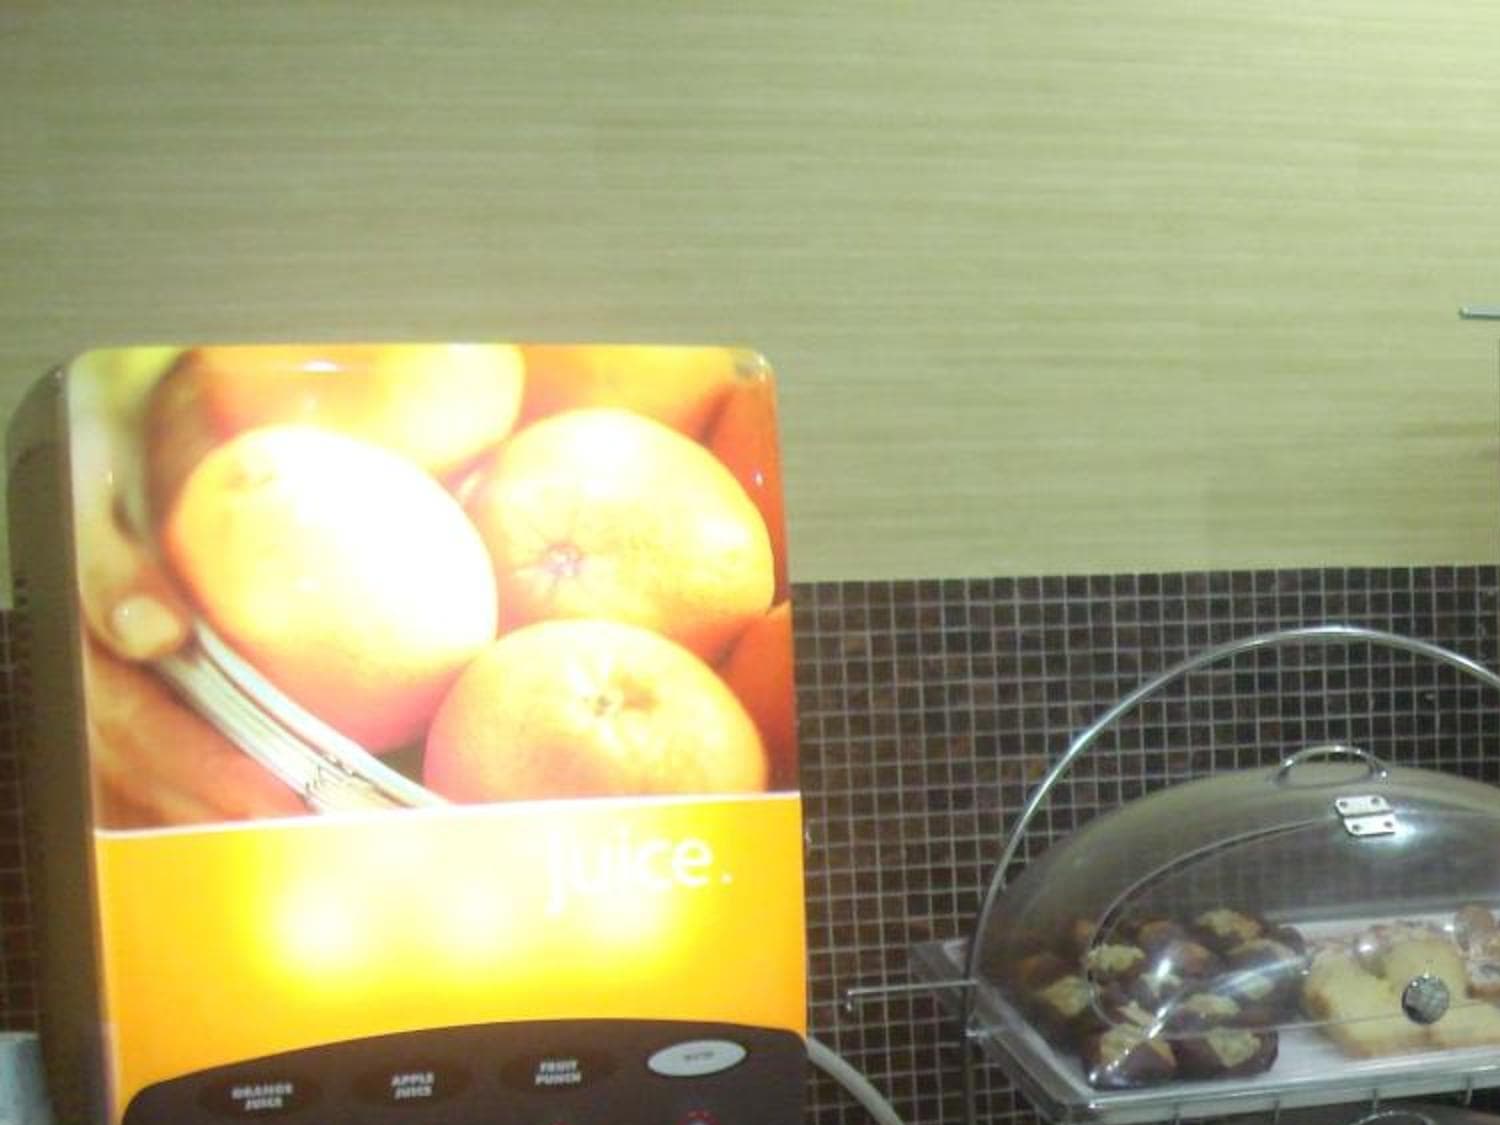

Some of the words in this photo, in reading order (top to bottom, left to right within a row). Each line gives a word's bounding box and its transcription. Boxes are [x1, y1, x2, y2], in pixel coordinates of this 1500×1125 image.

[391, 1072, 433, 1086] APPLE
[232, 1083, 293, 1099] ORANGE
[394, 1086, 432, 1099] JUICE
